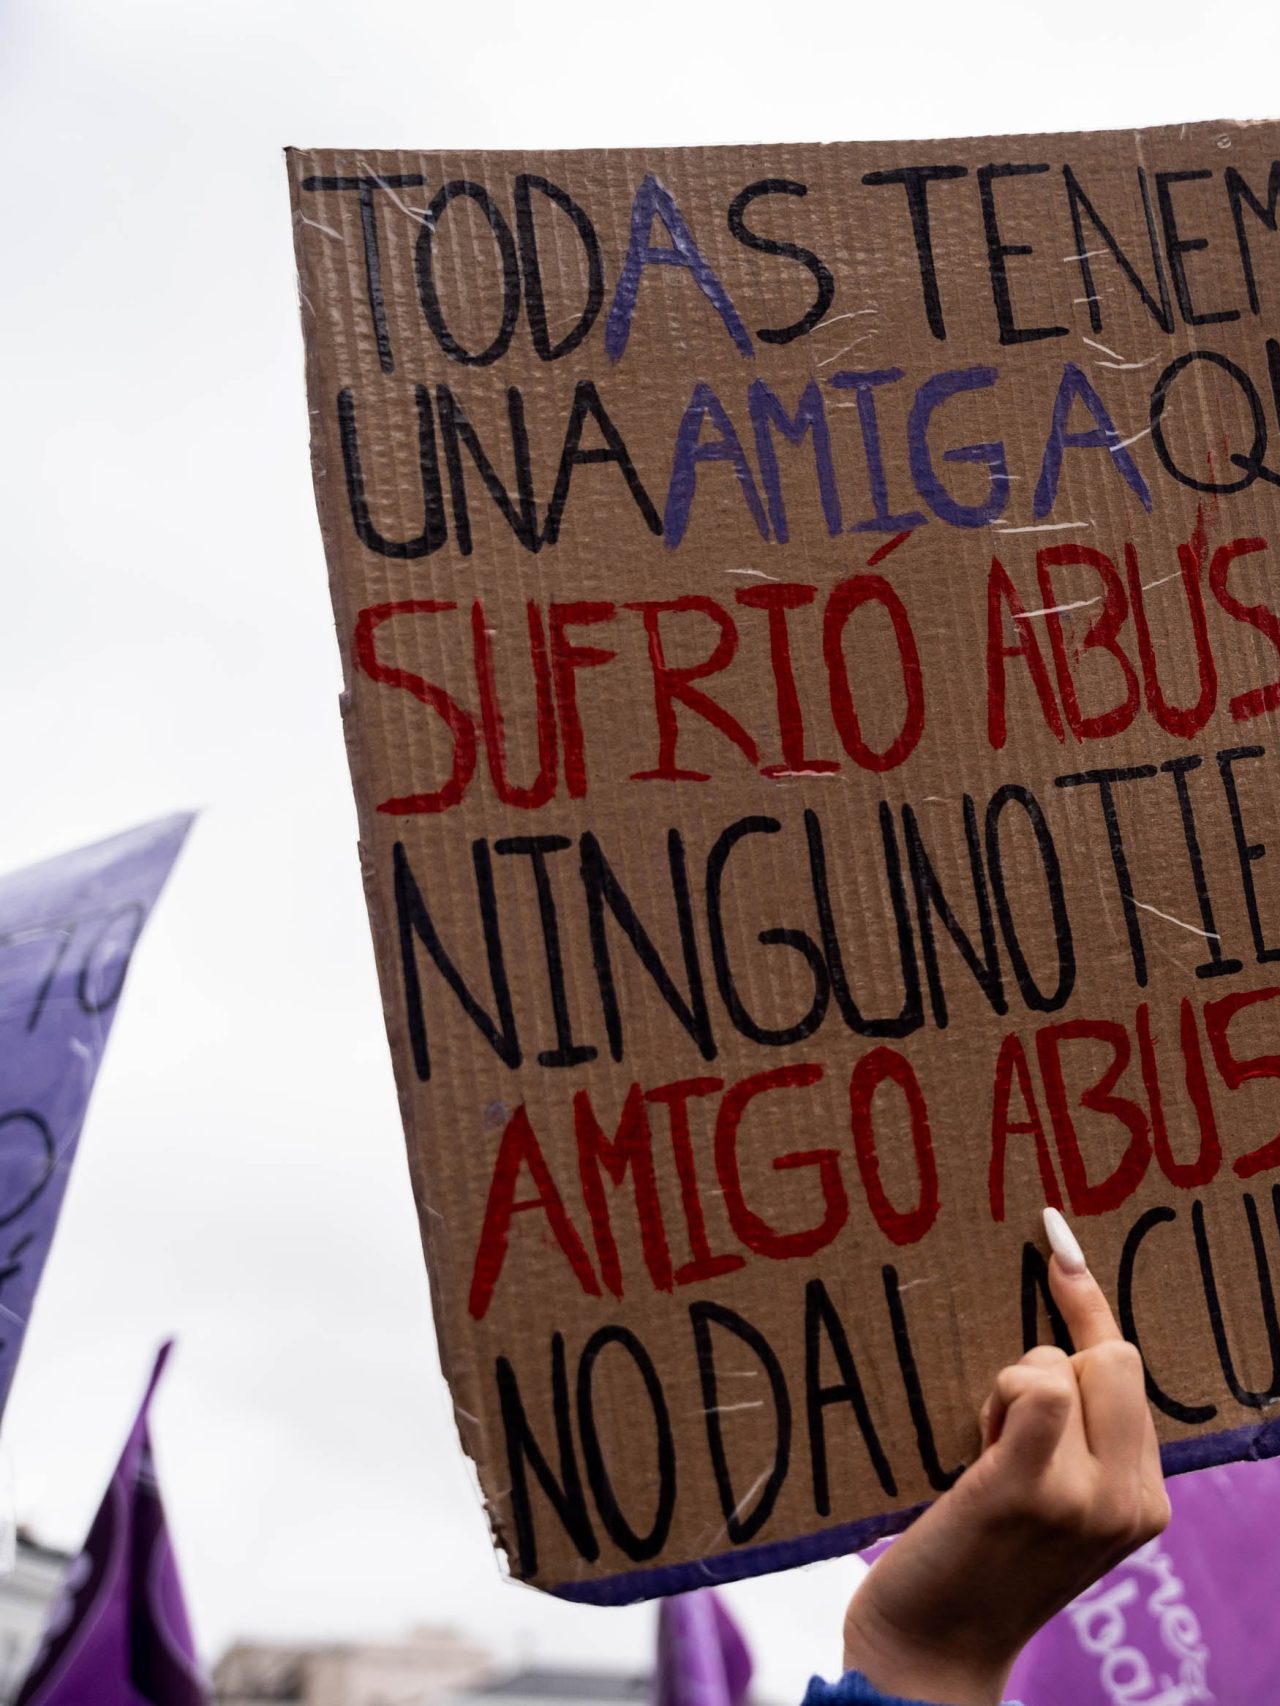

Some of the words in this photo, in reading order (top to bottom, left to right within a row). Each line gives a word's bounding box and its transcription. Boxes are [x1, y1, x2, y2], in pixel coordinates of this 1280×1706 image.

[302, 172, 834, 374] TODAS
[337, 379, 663, 559] UNA
[664, 361, 1153, 552] AMIGA
[353, 530, 924, 815] SUFRIÓ
[393, 783, 1076, 1082] NINGUNO
[468, 1046, 941, 1321] AMIGO
[495, 1324, 676, 1578] NO
